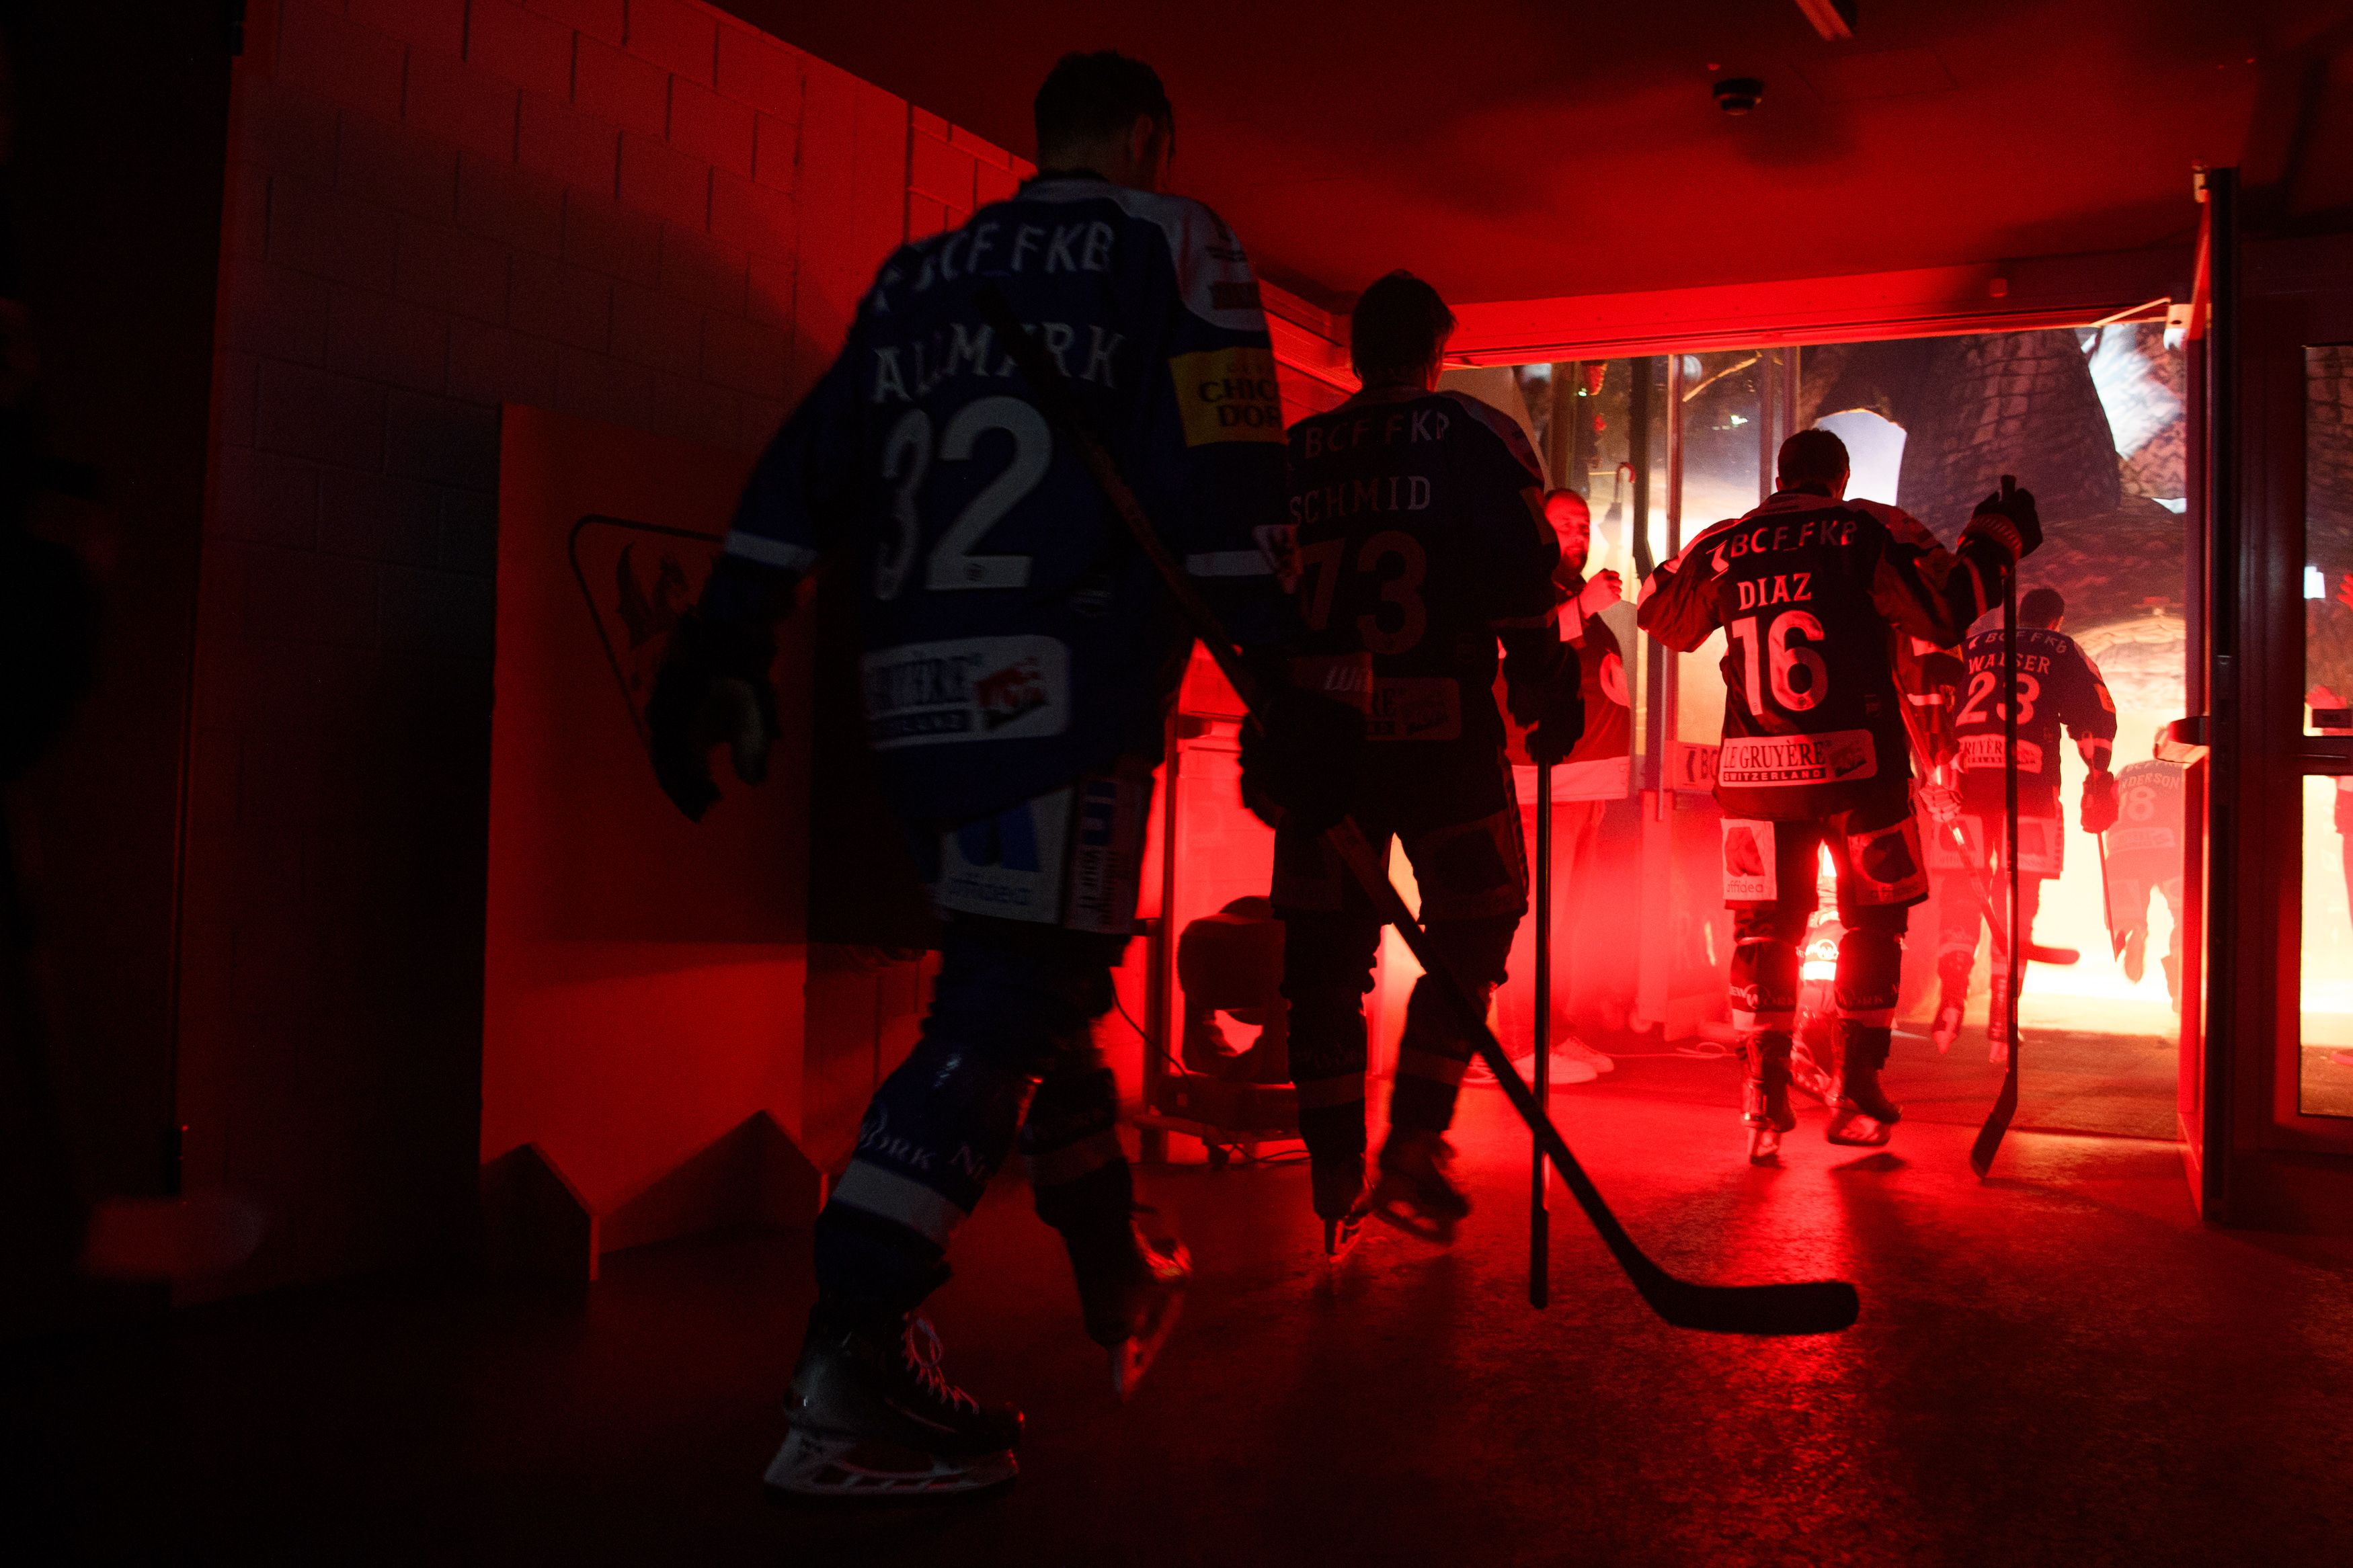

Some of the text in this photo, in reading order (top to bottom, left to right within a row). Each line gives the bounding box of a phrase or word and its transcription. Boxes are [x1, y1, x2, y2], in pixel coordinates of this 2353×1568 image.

[876, 395, 1053, 600] 32
[1289, 474, 1431, 526] SCHMID
[1300, 528, 1427, 655] 73
[1736, 572, 1812, 611] DIAZ
[1731, 609, 1829, 716] 16
[1955, 672, 2040, 728] 23
[1724, 770, 1823, 782] SWITZERLAND
[1740, 740, 1826, 769] GRUYÈRE
